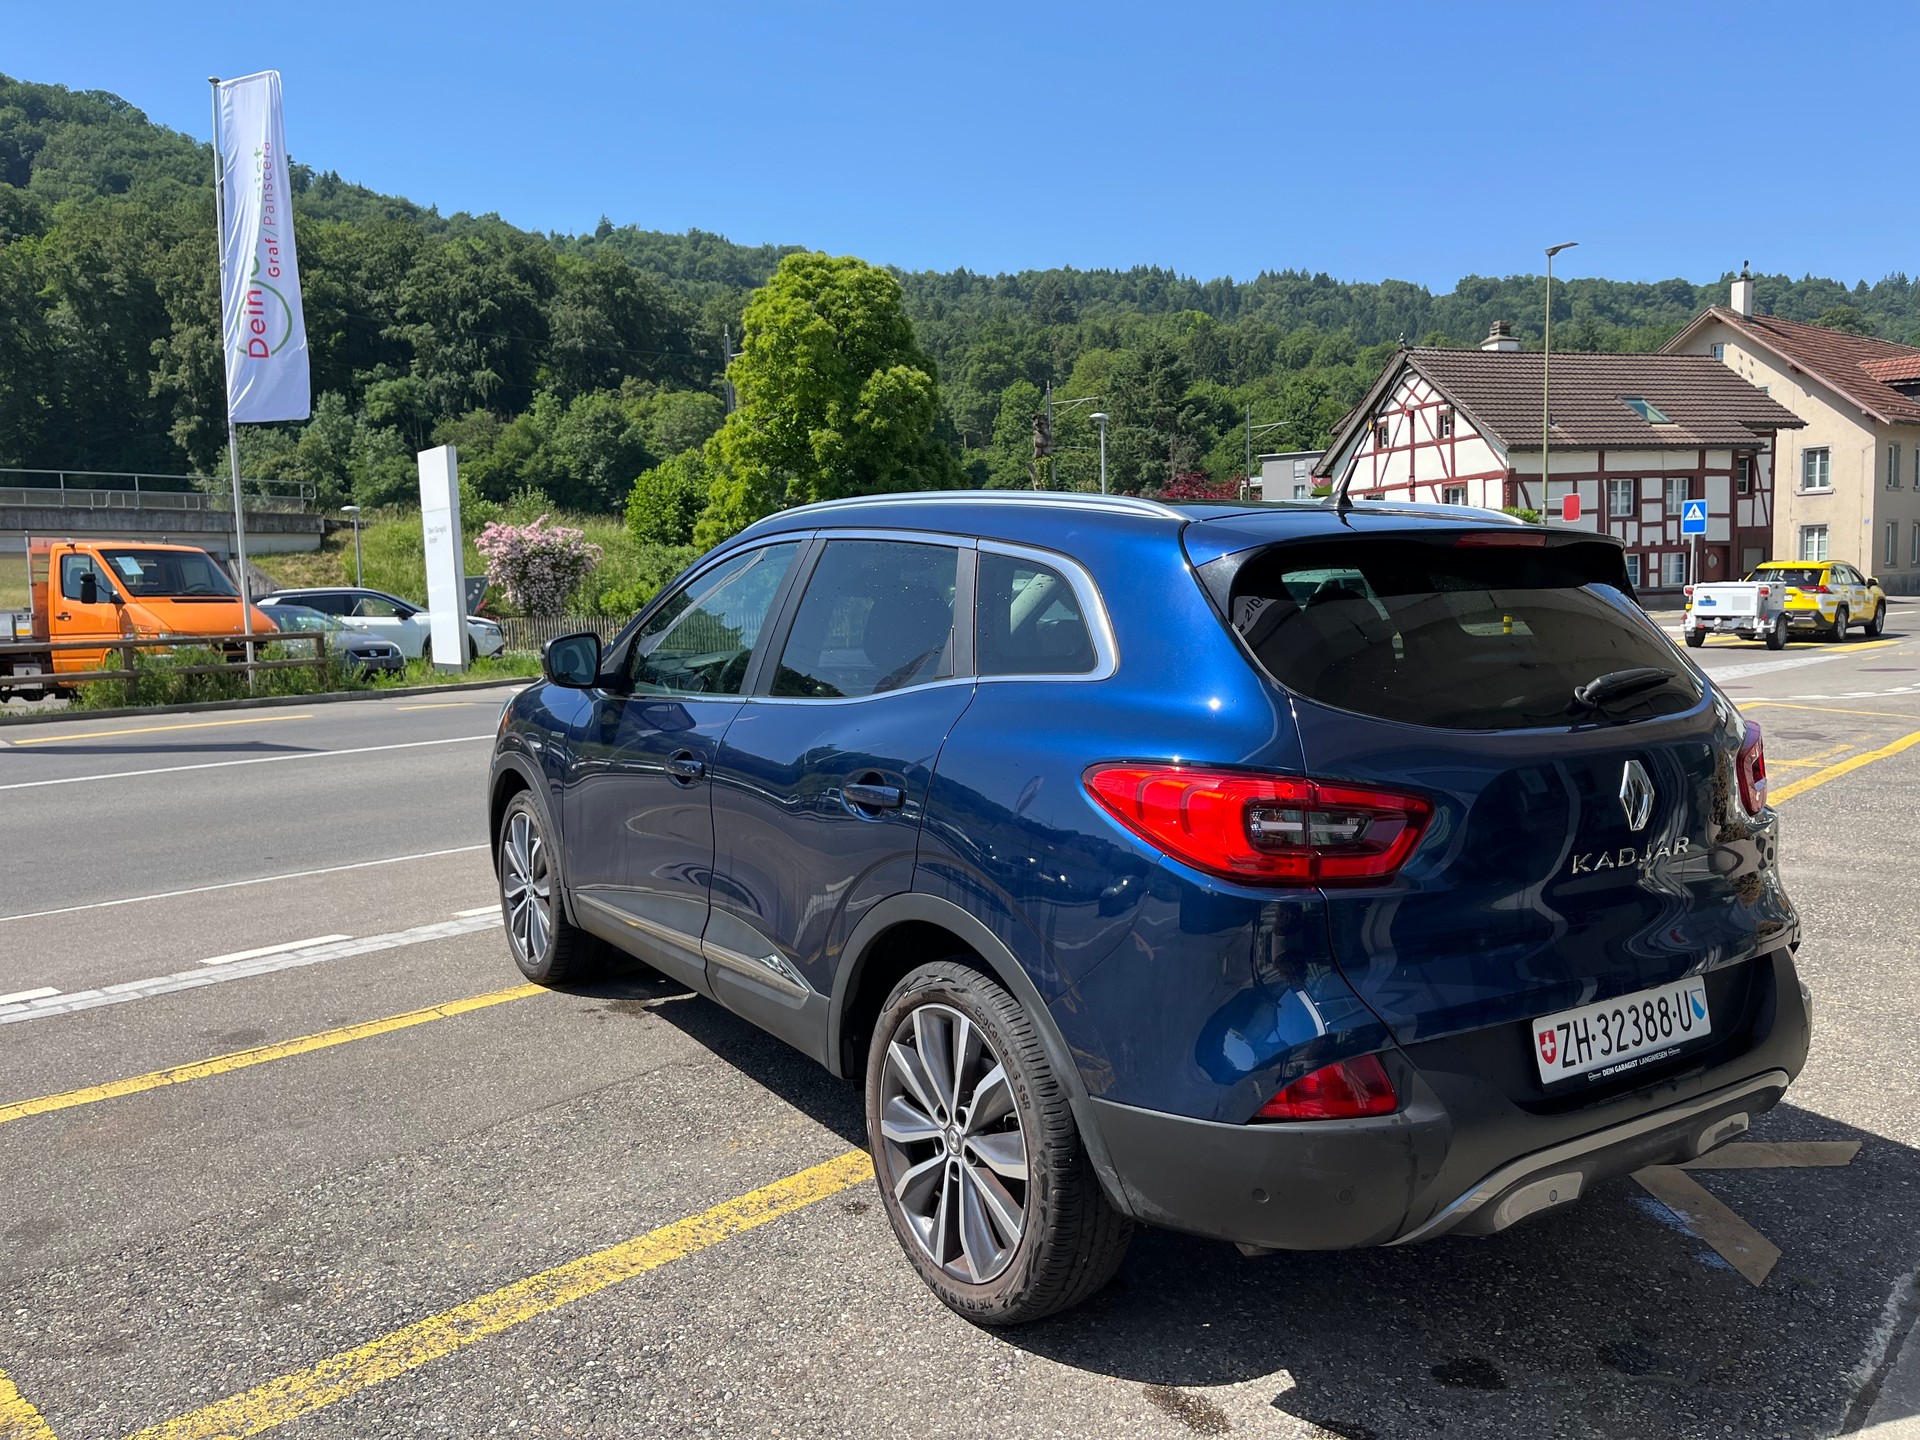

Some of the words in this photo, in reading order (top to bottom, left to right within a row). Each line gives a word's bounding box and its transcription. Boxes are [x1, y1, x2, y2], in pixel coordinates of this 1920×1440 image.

[243, 290, 269, 358] Dein
[1571, 835, 1690, 875] KADJAR
[1602, 1066, 1615, 1077] DEIN
[1614, 1059, 1638, 1073] GARAGIST
[1638, 1051, 1668, 1066] LANGWIESEN
